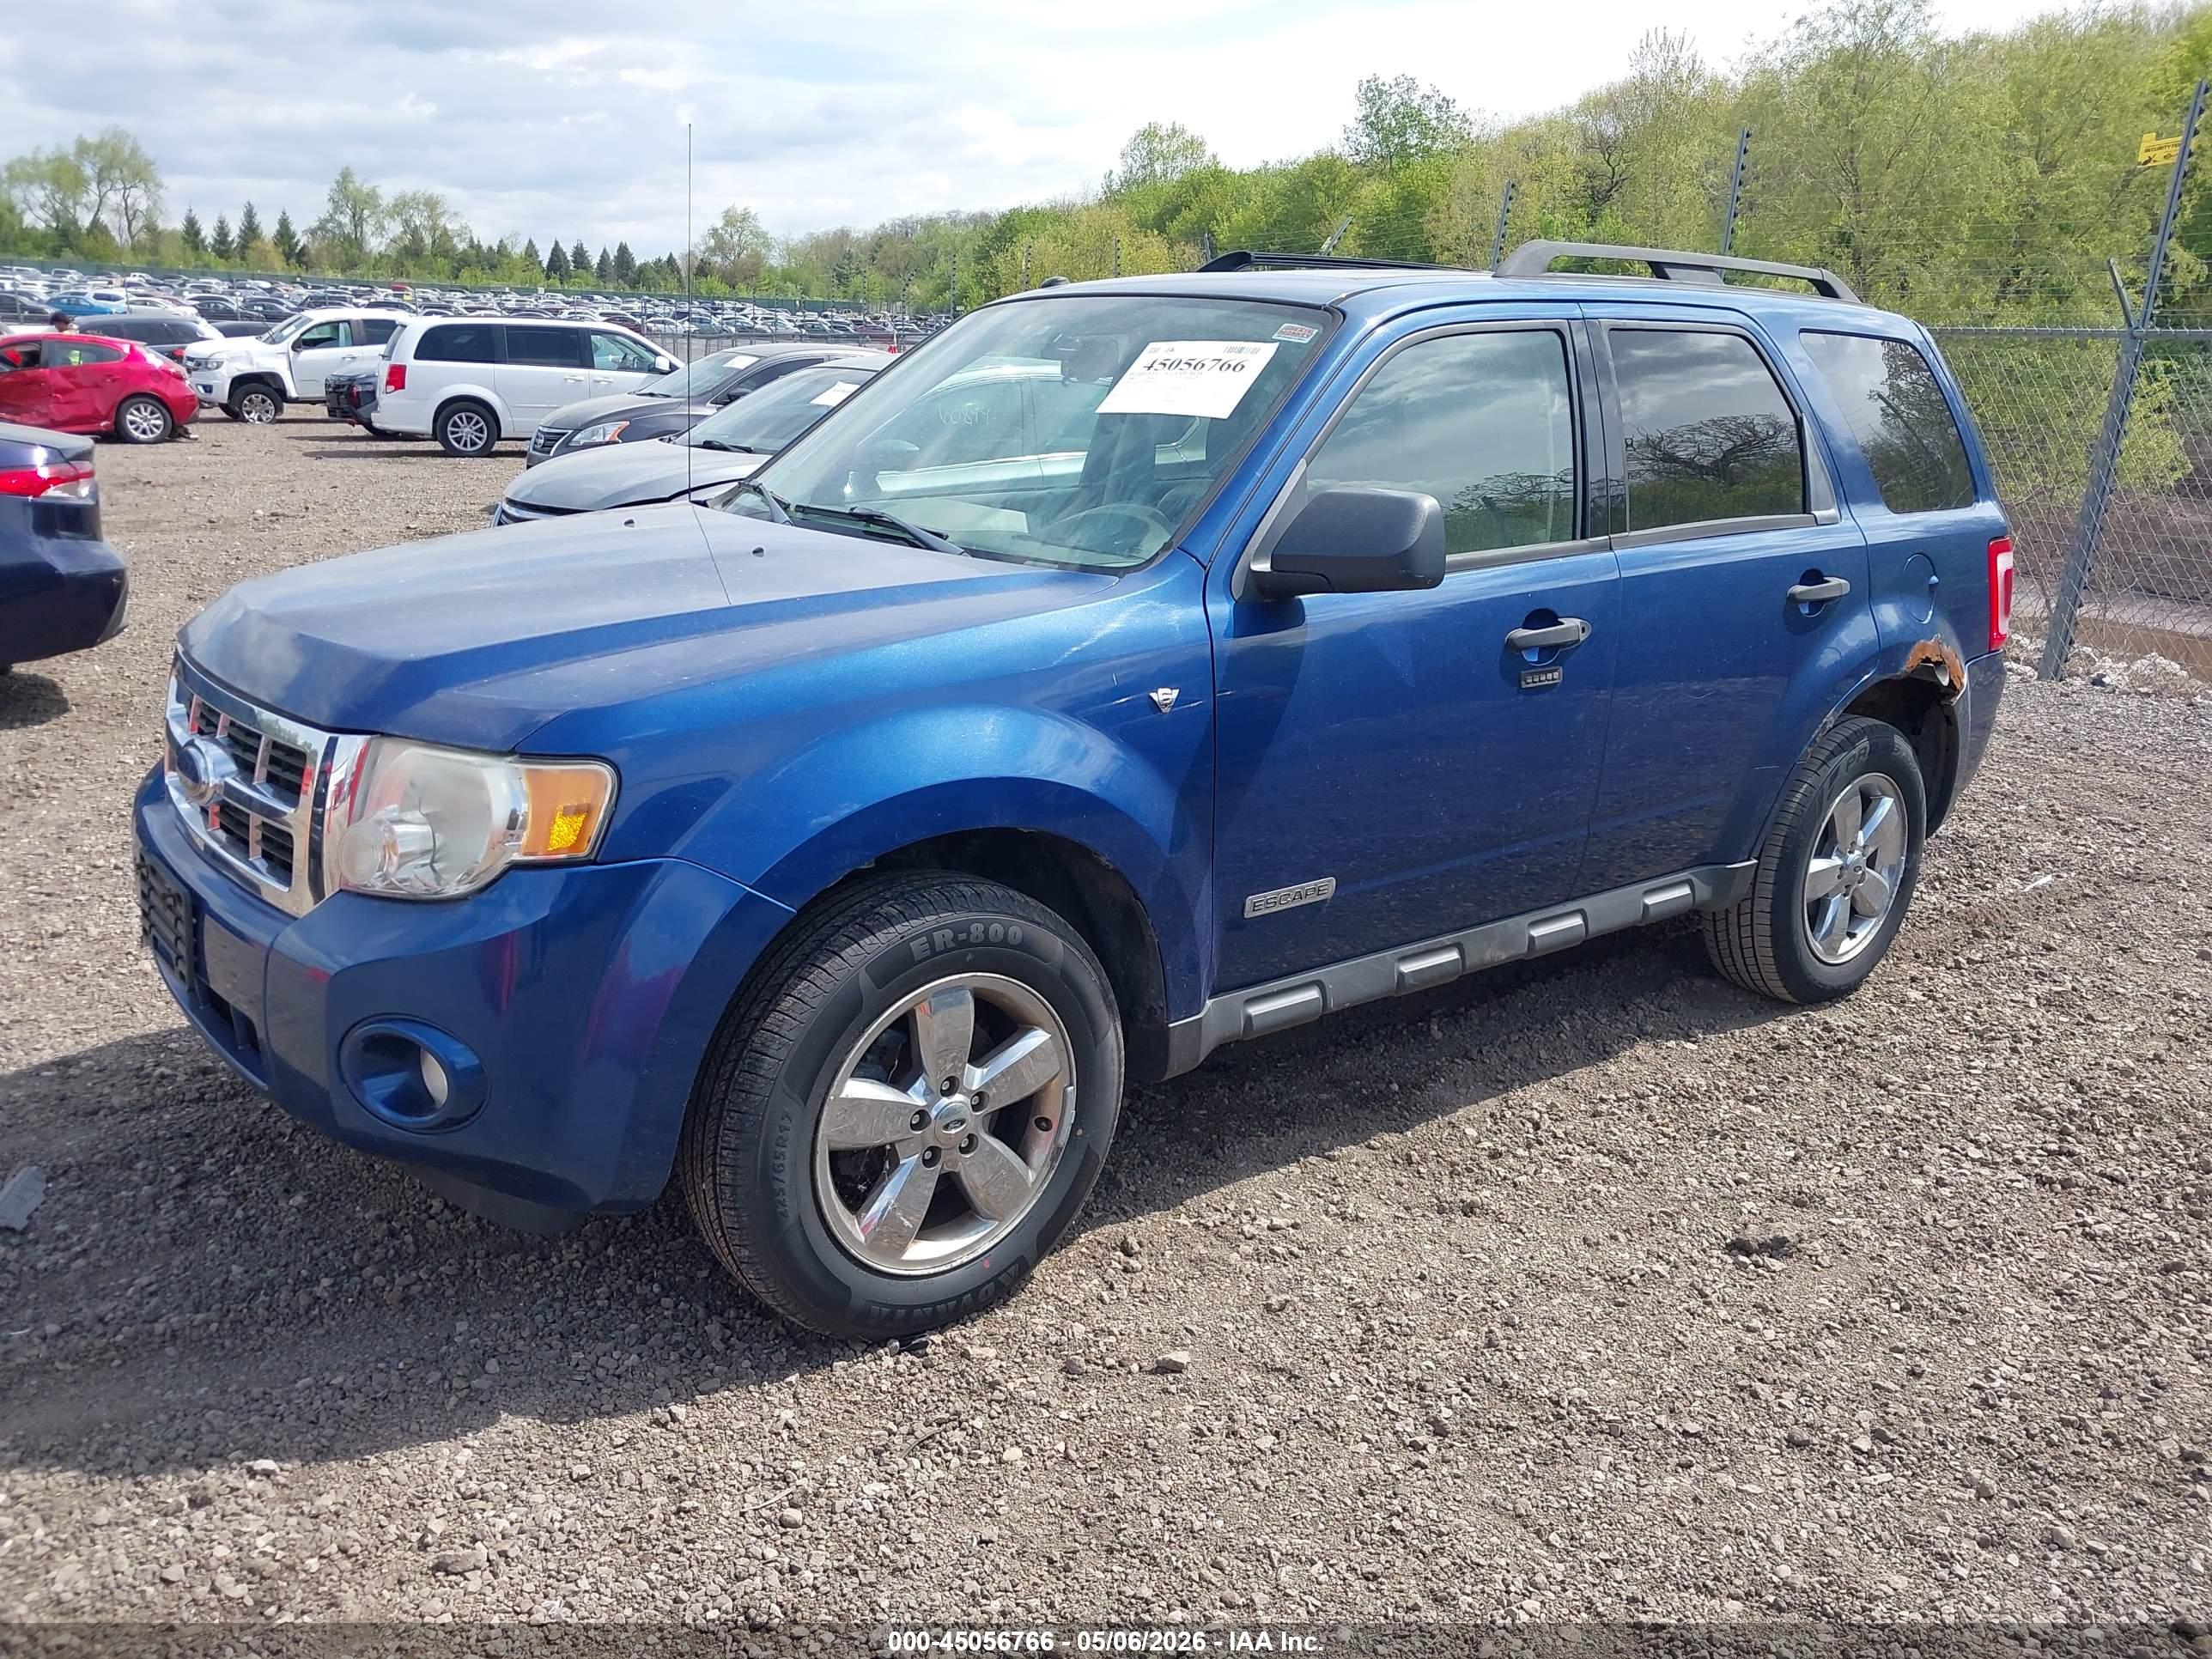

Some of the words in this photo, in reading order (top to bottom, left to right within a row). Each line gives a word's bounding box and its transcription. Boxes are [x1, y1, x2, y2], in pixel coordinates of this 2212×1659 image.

[1143, 357, 1249, 373] 45056766
[1252, 883, 1329, 912] ESCAPE
[910, 923, 1024, 961] ER-800
